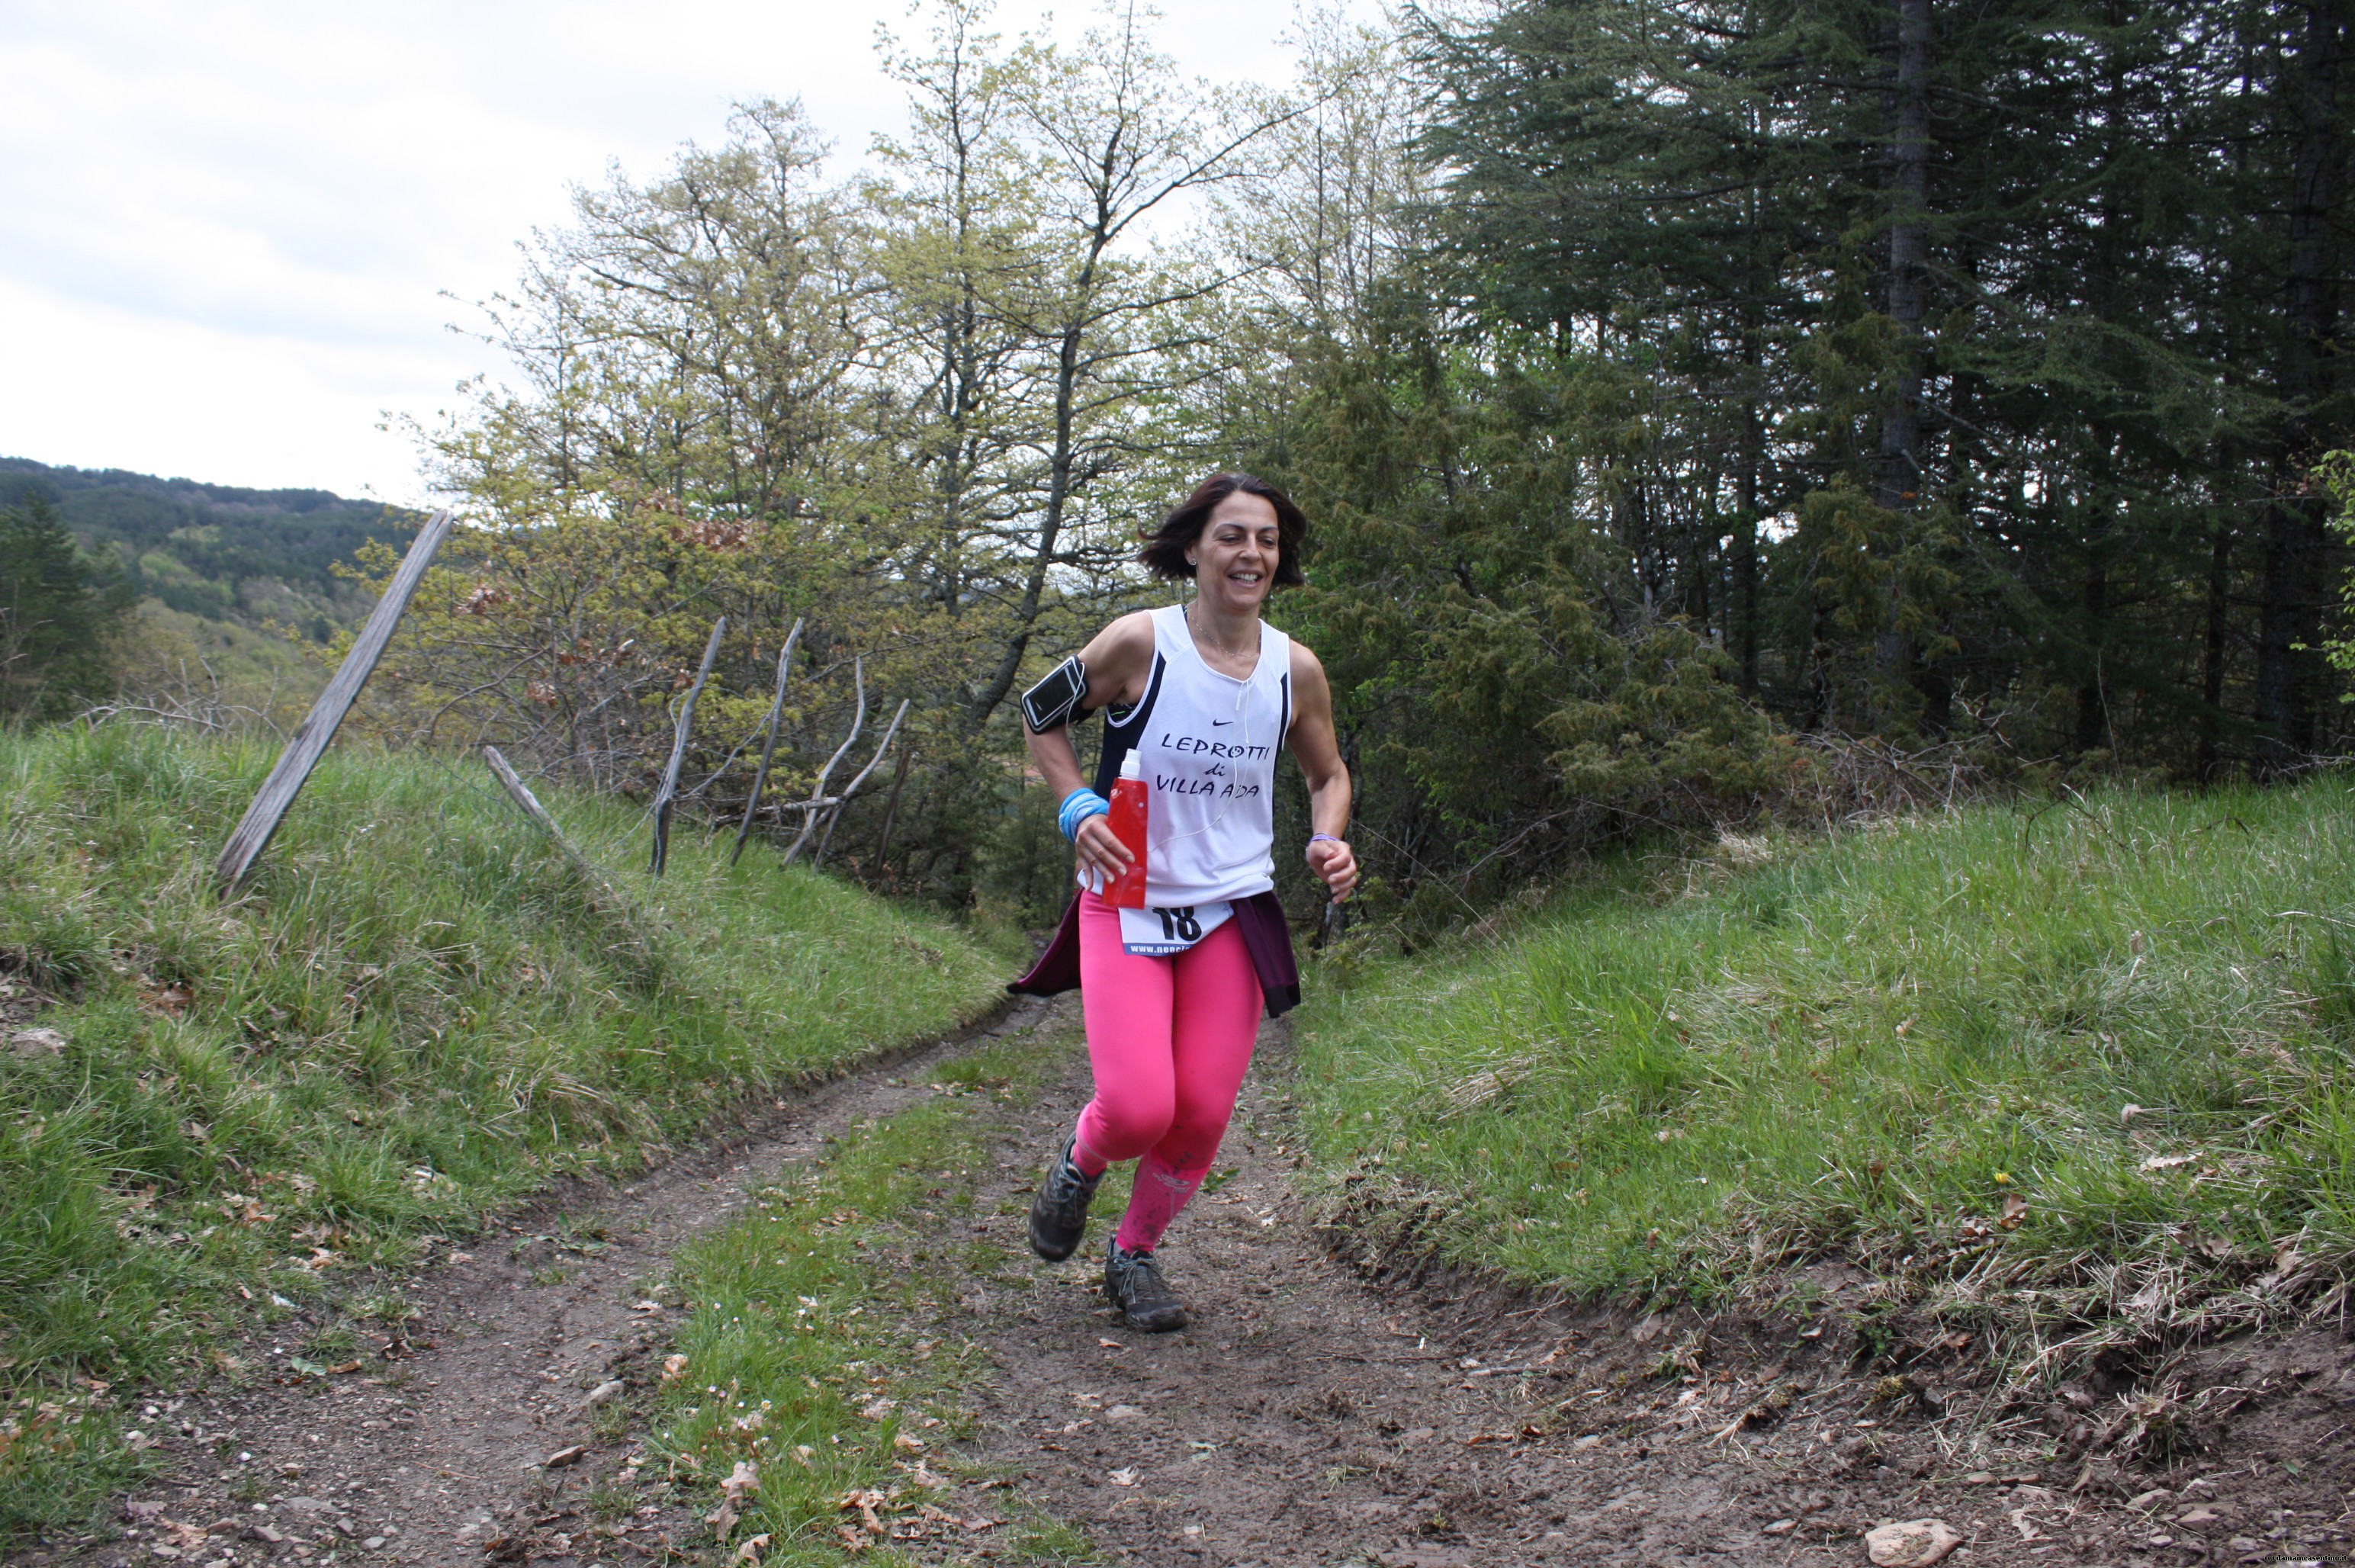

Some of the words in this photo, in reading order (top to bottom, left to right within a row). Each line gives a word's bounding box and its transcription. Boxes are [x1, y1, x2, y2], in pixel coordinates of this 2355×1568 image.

[1161, 733, 1270, 760] LEPROTTI
[1203, 762, 1226, 776] di
[1156, 774, 1215, 795] VILLA
[1219, 783, 1260, 798] ADA
[1152, 906, 1202, 941] 18
[1130, 945, 1191, 953] www.nenci
